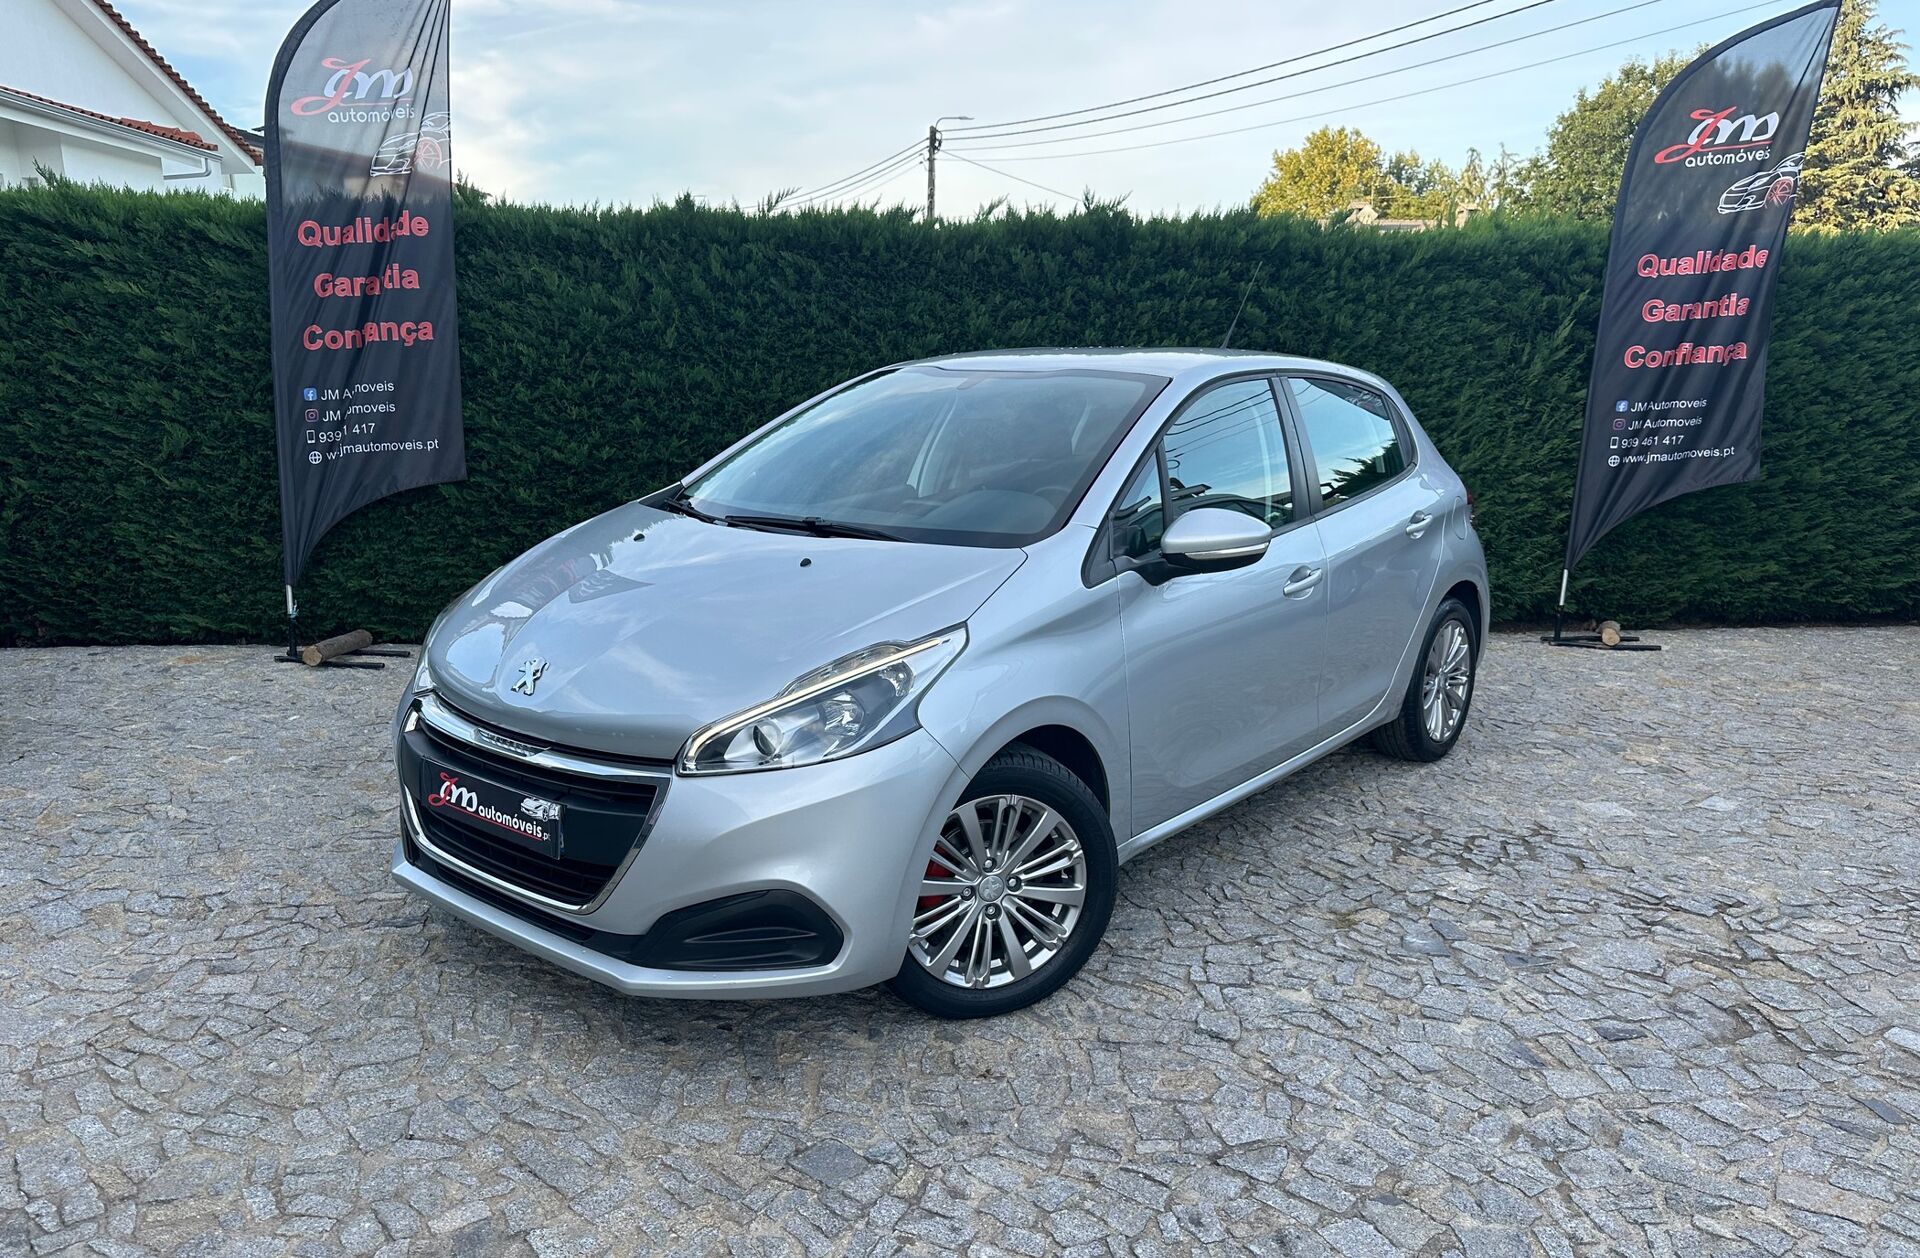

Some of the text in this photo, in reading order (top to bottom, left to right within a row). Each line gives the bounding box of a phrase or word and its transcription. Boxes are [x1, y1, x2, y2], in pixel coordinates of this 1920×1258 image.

[1637, 245, 1769, 278] Qualidade
[314, 263, 420, 298] Garatia
[1642, 293, 1750, 322] Garantia
[303, 321, 434, 350] Conança
[1624, 342, 1747, 369] Confiança
[321, 389, 340, 400] JM
[1630, 398, 1707, 412] JM Automoveis
[322, 410, 341, 422] JM
[1628, 416, 1702, 430] JM Automoveis
[352, 423, 376, 435] 417
[1662, 435, 1684, 446] 417
[1622, 446, 1735, 464] www.jmautomoveis.pt
